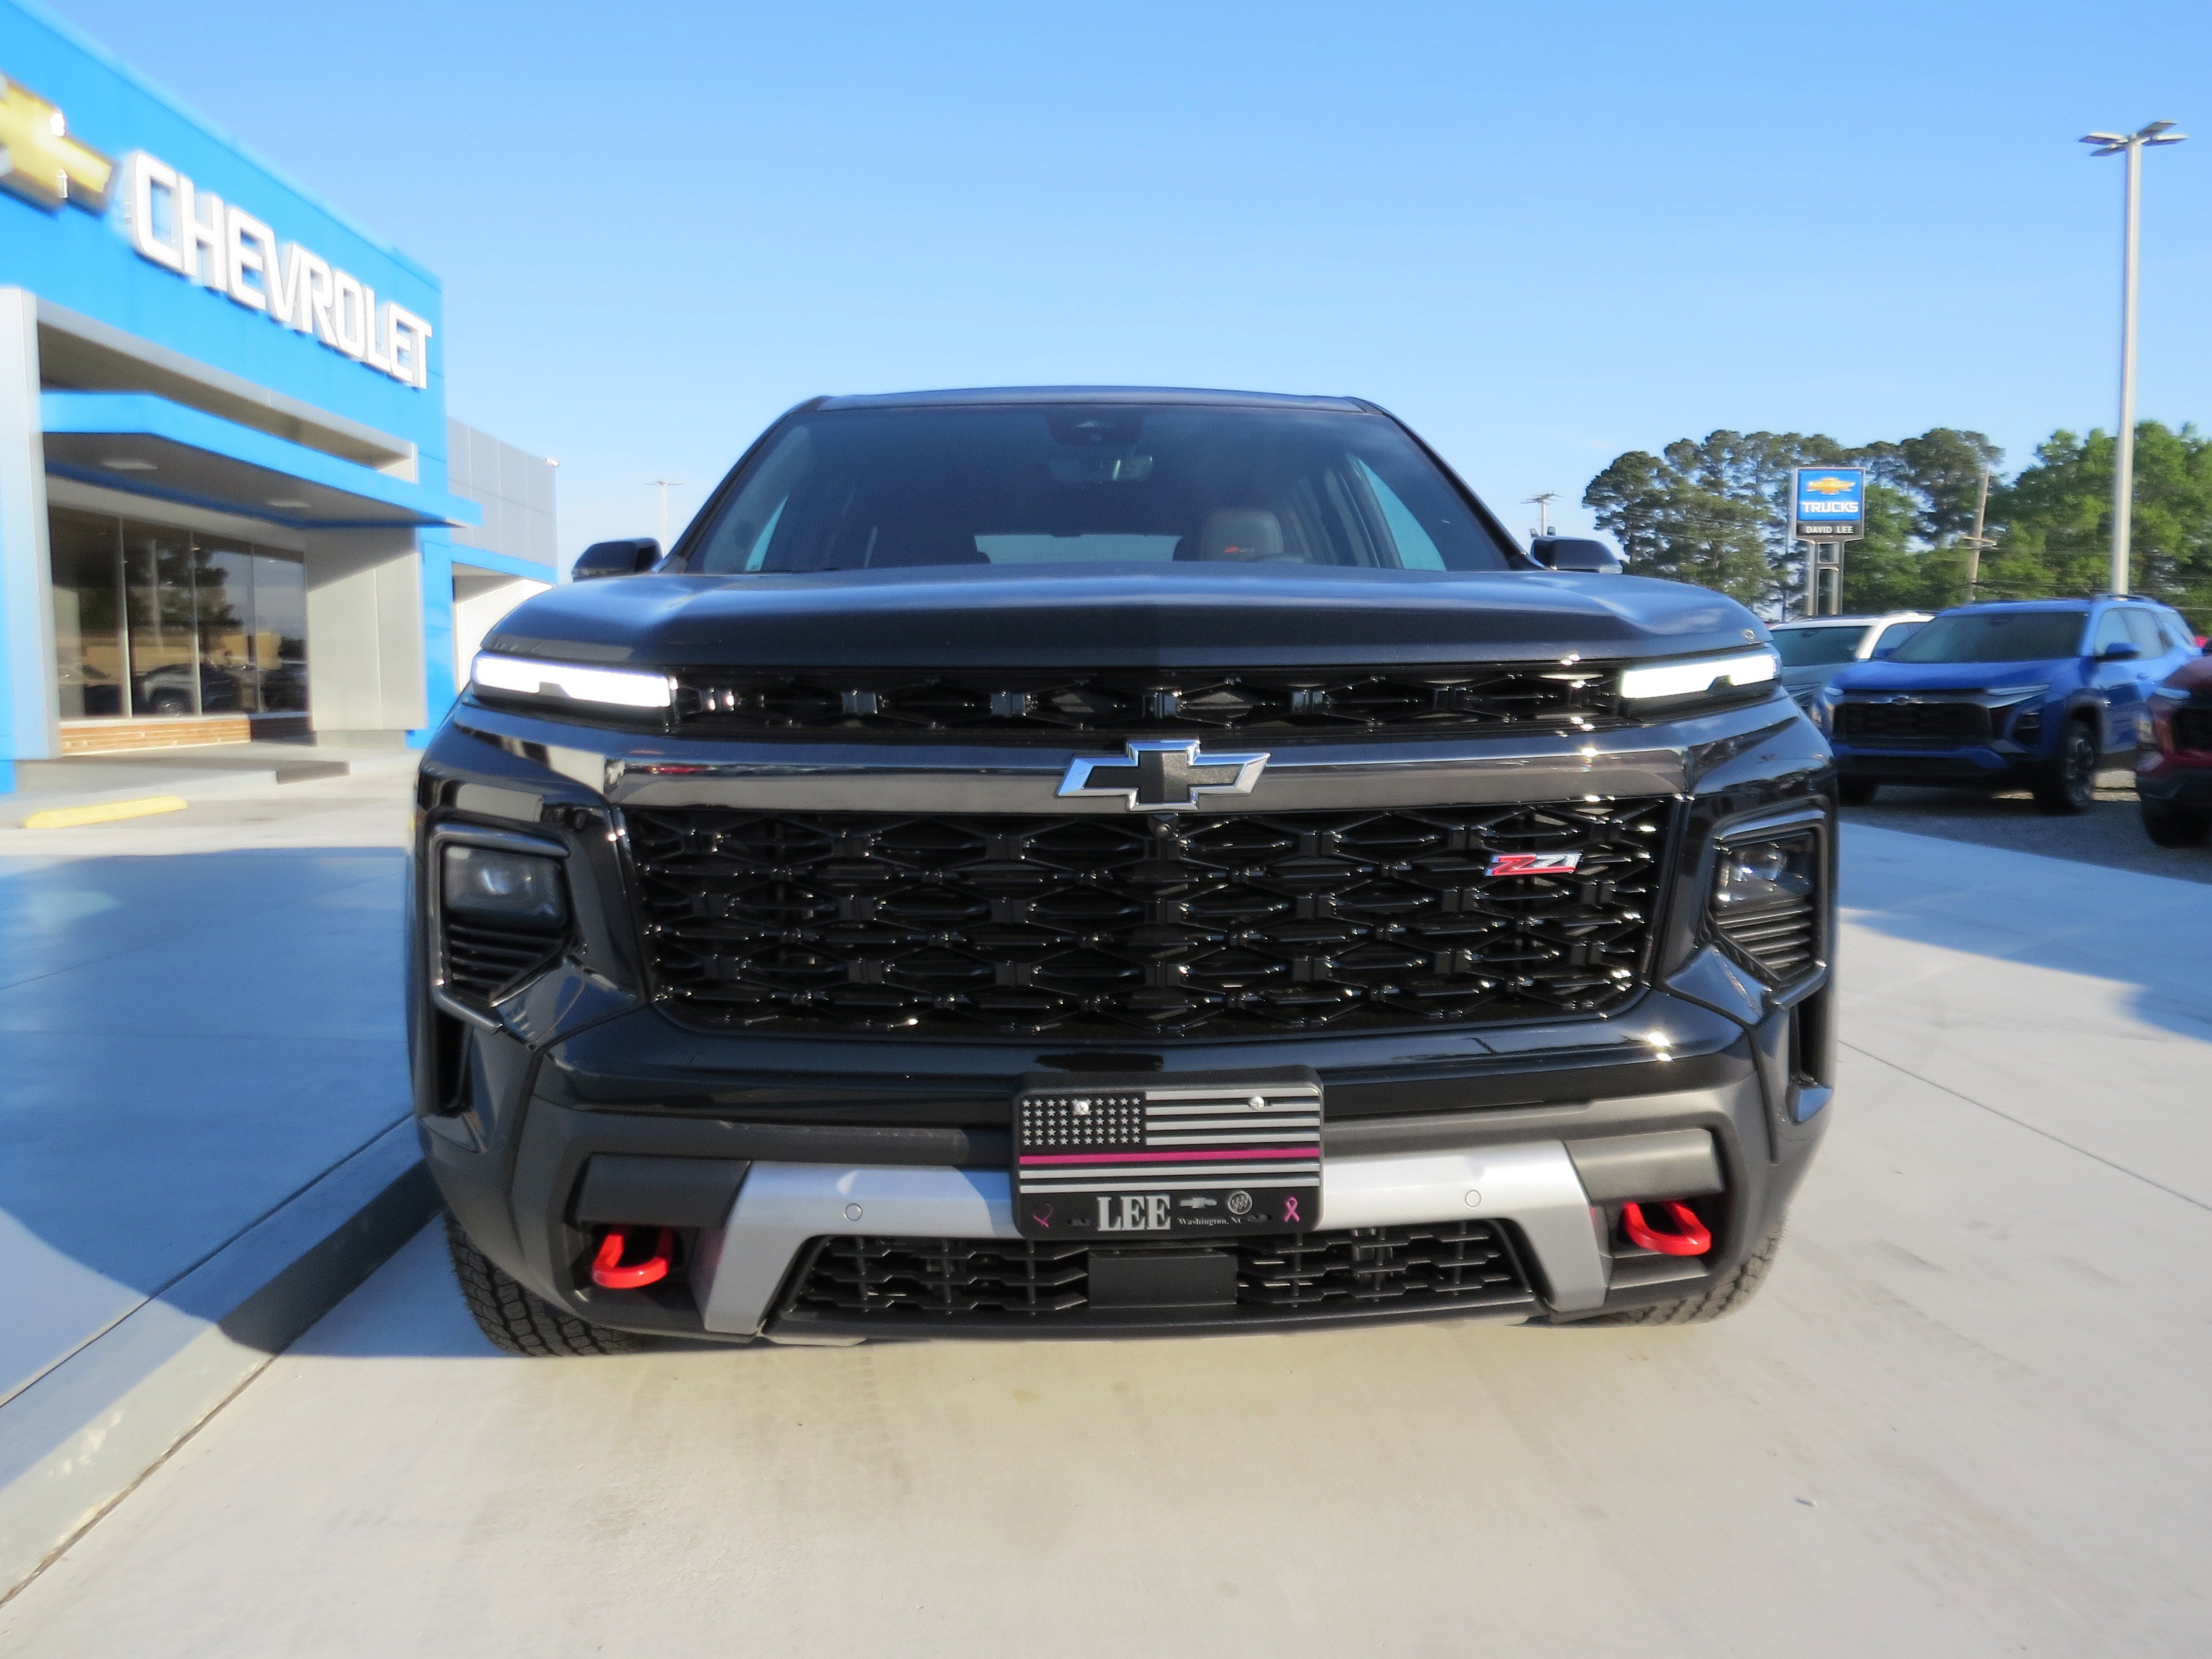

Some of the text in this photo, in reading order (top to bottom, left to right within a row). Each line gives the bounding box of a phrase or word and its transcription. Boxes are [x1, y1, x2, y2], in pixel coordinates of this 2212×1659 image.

[131, 150, 432, 390] CHEVROLET
[1802, 502, 1859, 513] TRUCKS
[1485, 854, 1582, 876] Z71
[1097, 1195, 1171, 1232] LEE
